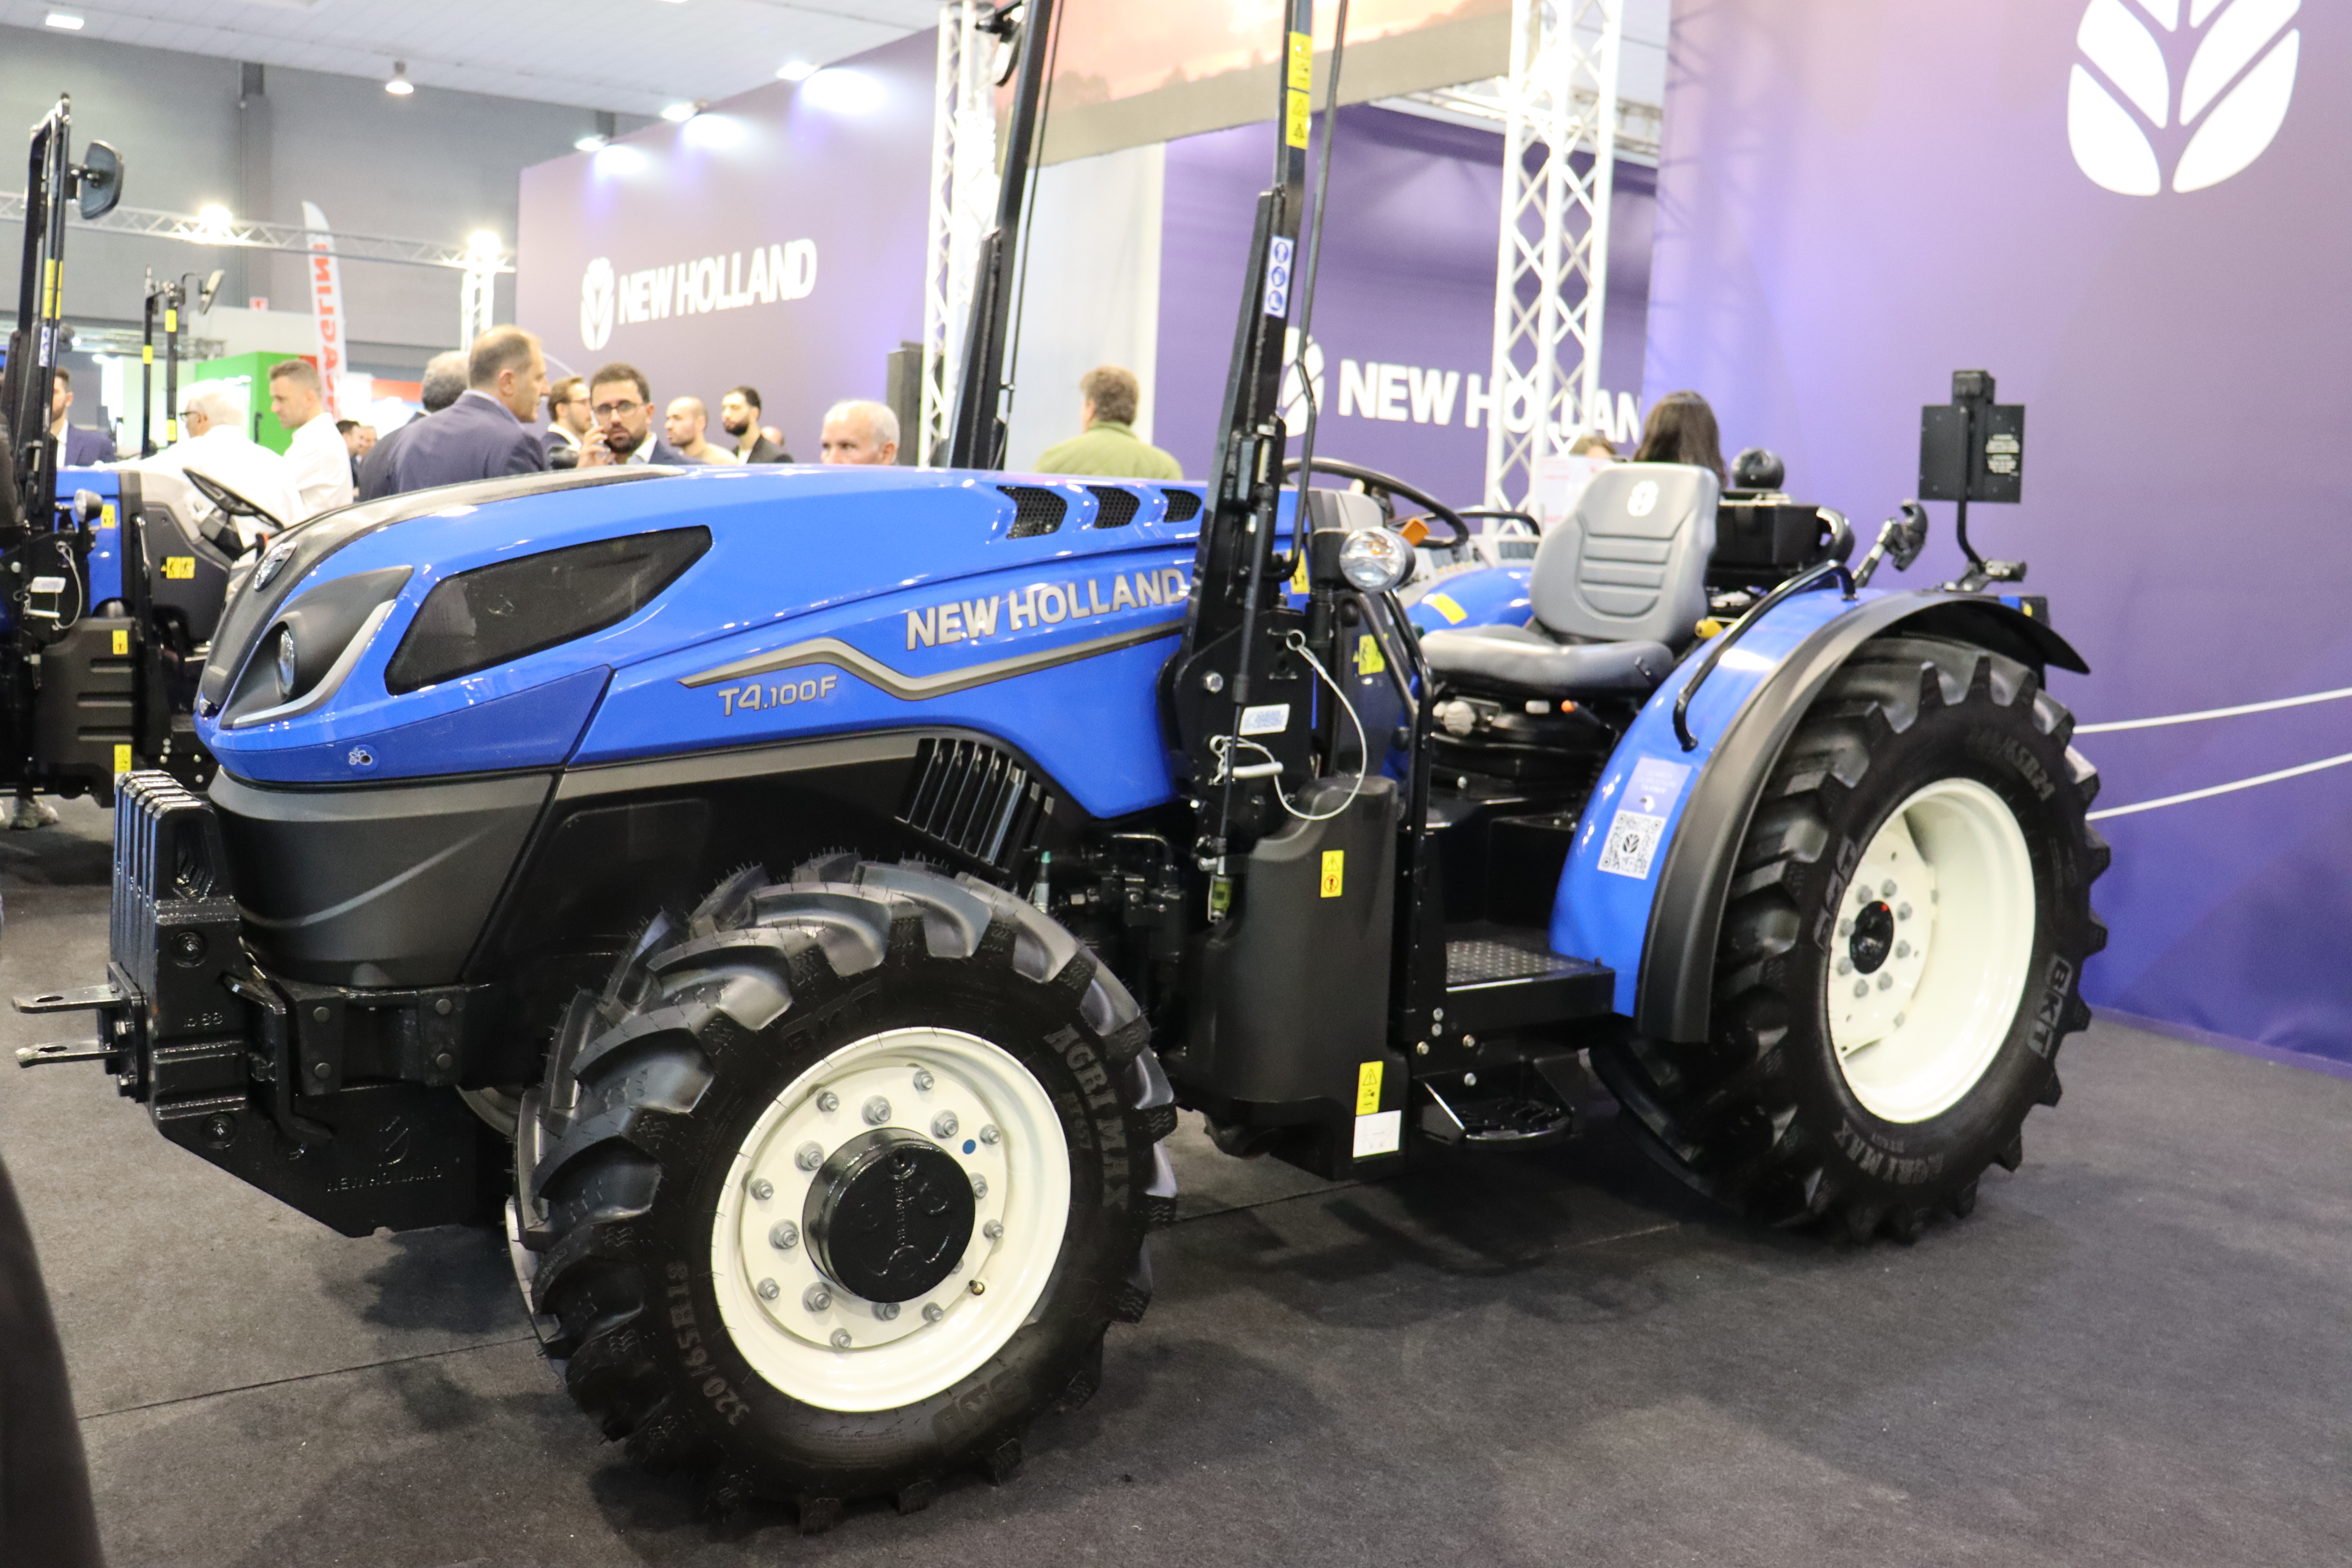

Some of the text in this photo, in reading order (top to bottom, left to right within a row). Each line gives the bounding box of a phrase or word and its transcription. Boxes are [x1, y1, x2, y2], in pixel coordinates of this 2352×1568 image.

[618, 238, 818, 325] NEW HOLLAND
[1338, 358, 1642, 445] NEW HOLAN
[906, 567, 1187, 651] NEW HOLLAND
[717, 674, 838, 717] T4.100F
[2026, 953, 2073, 1059] BKT
[1043, 1023, 1130, 1210] AGRI MAX
[1833, 1118, 1884, 1176] MAX
[667, 1260, 750, 1426] 320/65R18
